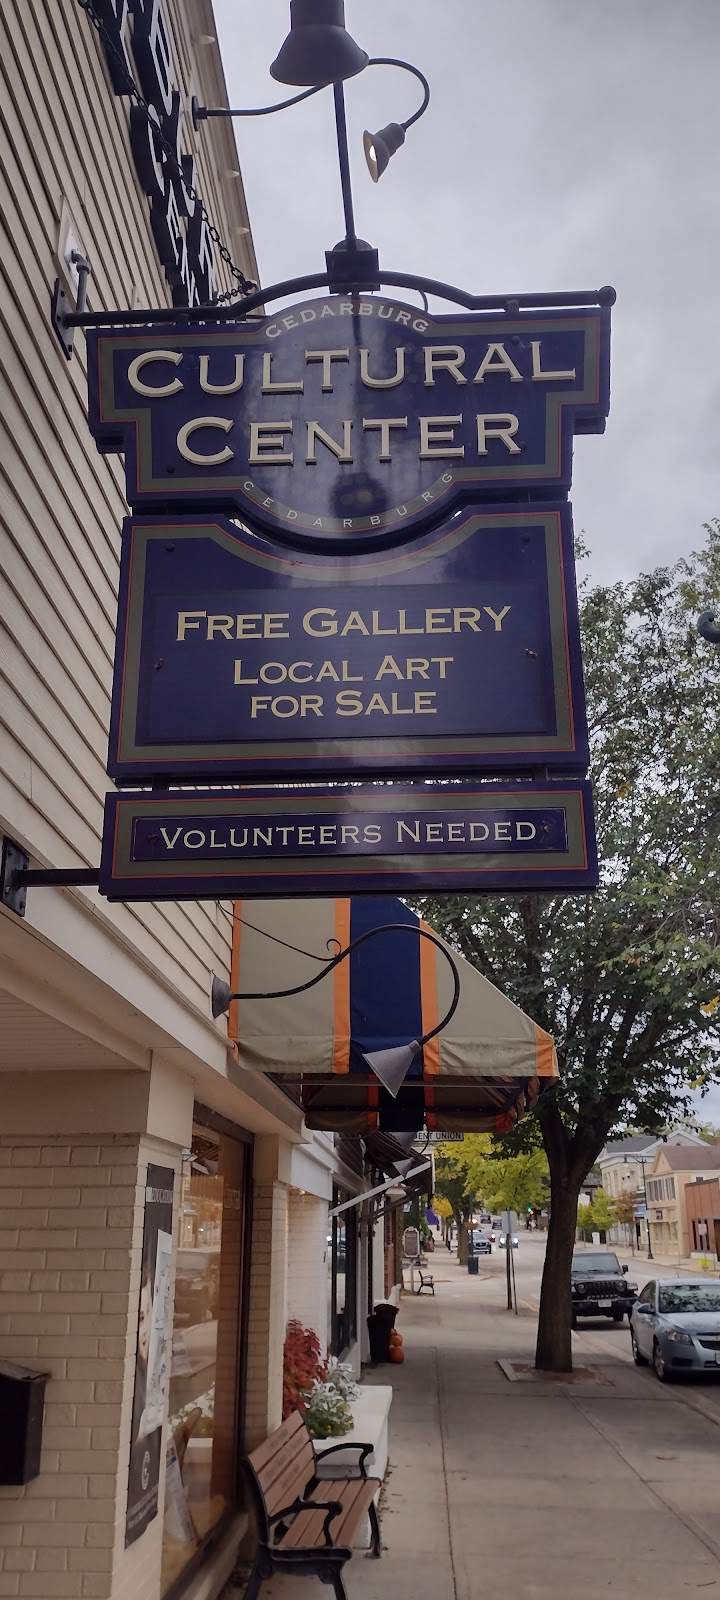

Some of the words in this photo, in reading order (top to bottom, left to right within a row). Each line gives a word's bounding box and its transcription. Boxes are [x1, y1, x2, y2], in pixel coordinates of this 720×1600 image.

[265, 302, 431, 339] CEDARBURG
[127, 340, 577, 398] CULTURAL
[176, 412, 522, 466] CENTER
[242, 471, 455, 529] CEDARBURG
[176, 609, 290, 642] FREE
[302, 605, 512, 638] GALLERY
[233, 659, 363, 686] LOCAL
[374, 654, 454, 681] ART
[250, 695, 324, 719] FOR
[335, 690, 438, 717] SALE
[159, 822, 383, 850] VOLUNTEERS
[396, 818, 538, 844] NEEDED
